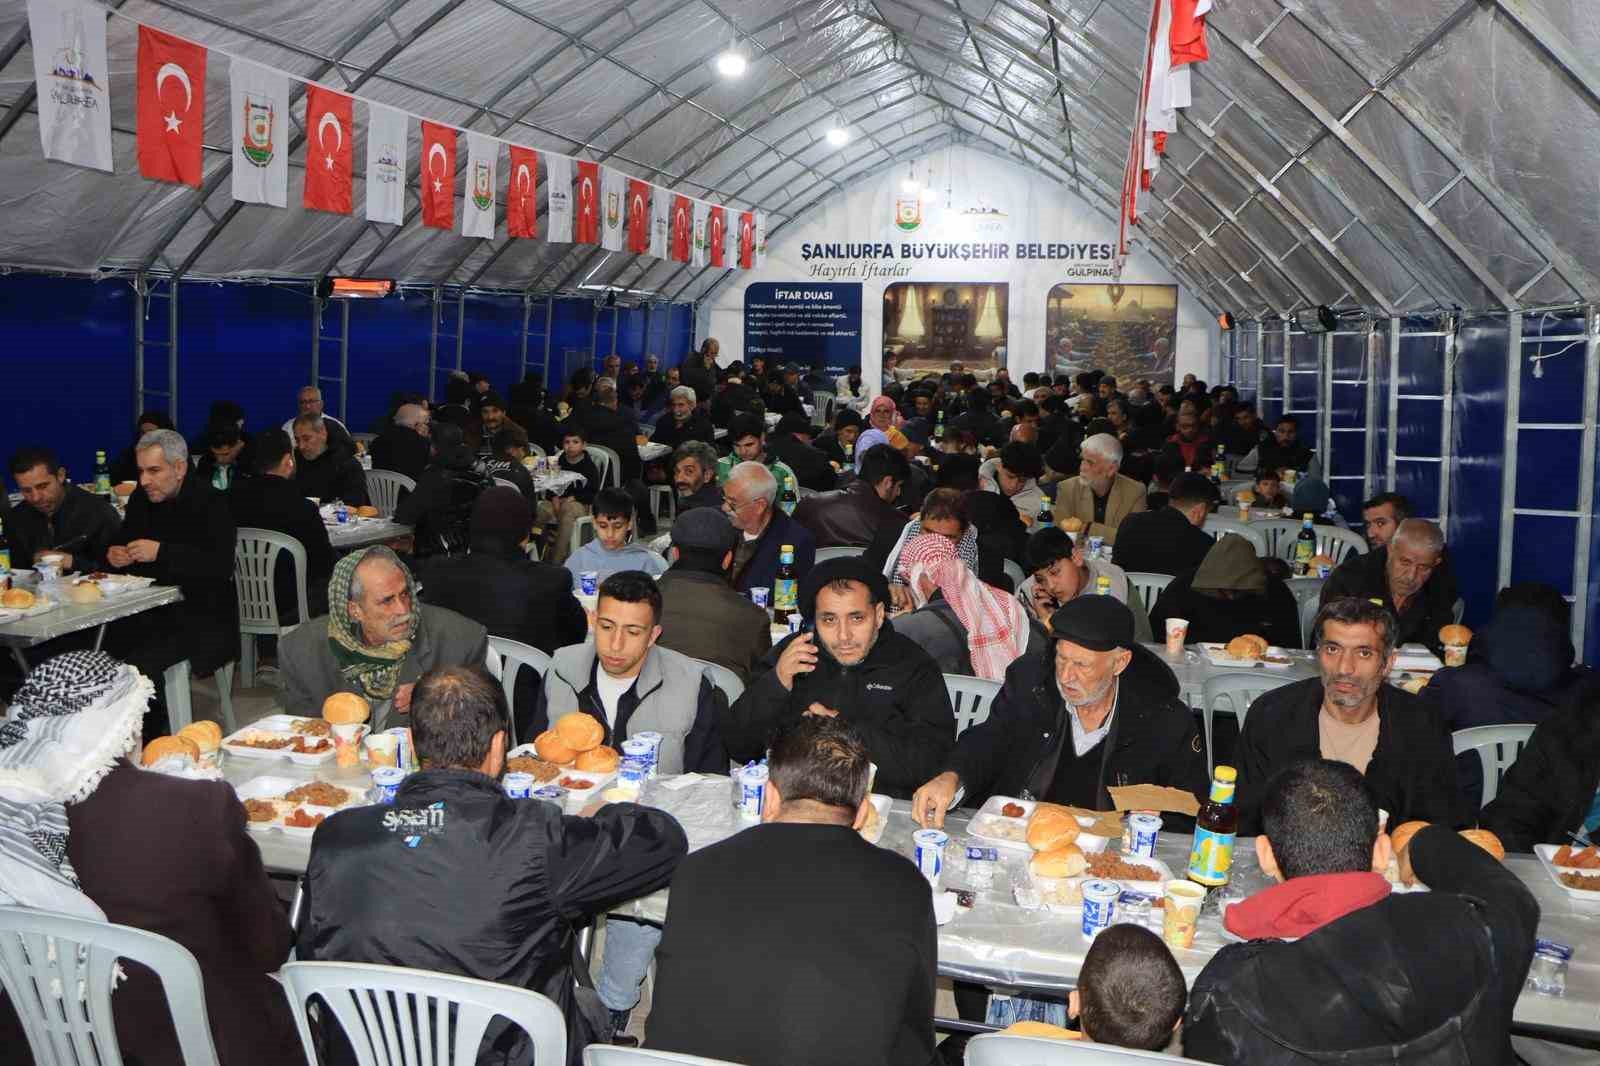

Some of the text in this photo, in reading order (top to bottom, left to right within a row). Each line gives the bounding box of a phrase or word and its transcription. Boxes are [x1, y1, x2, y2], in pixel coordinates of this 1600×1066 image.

[801, 243, 894, 261] ŞANLIURFA
[901, 243, 1009, 261] BÜYÜKŞEHİR
[775, 288, 833, 300] İFTAR DUASI
